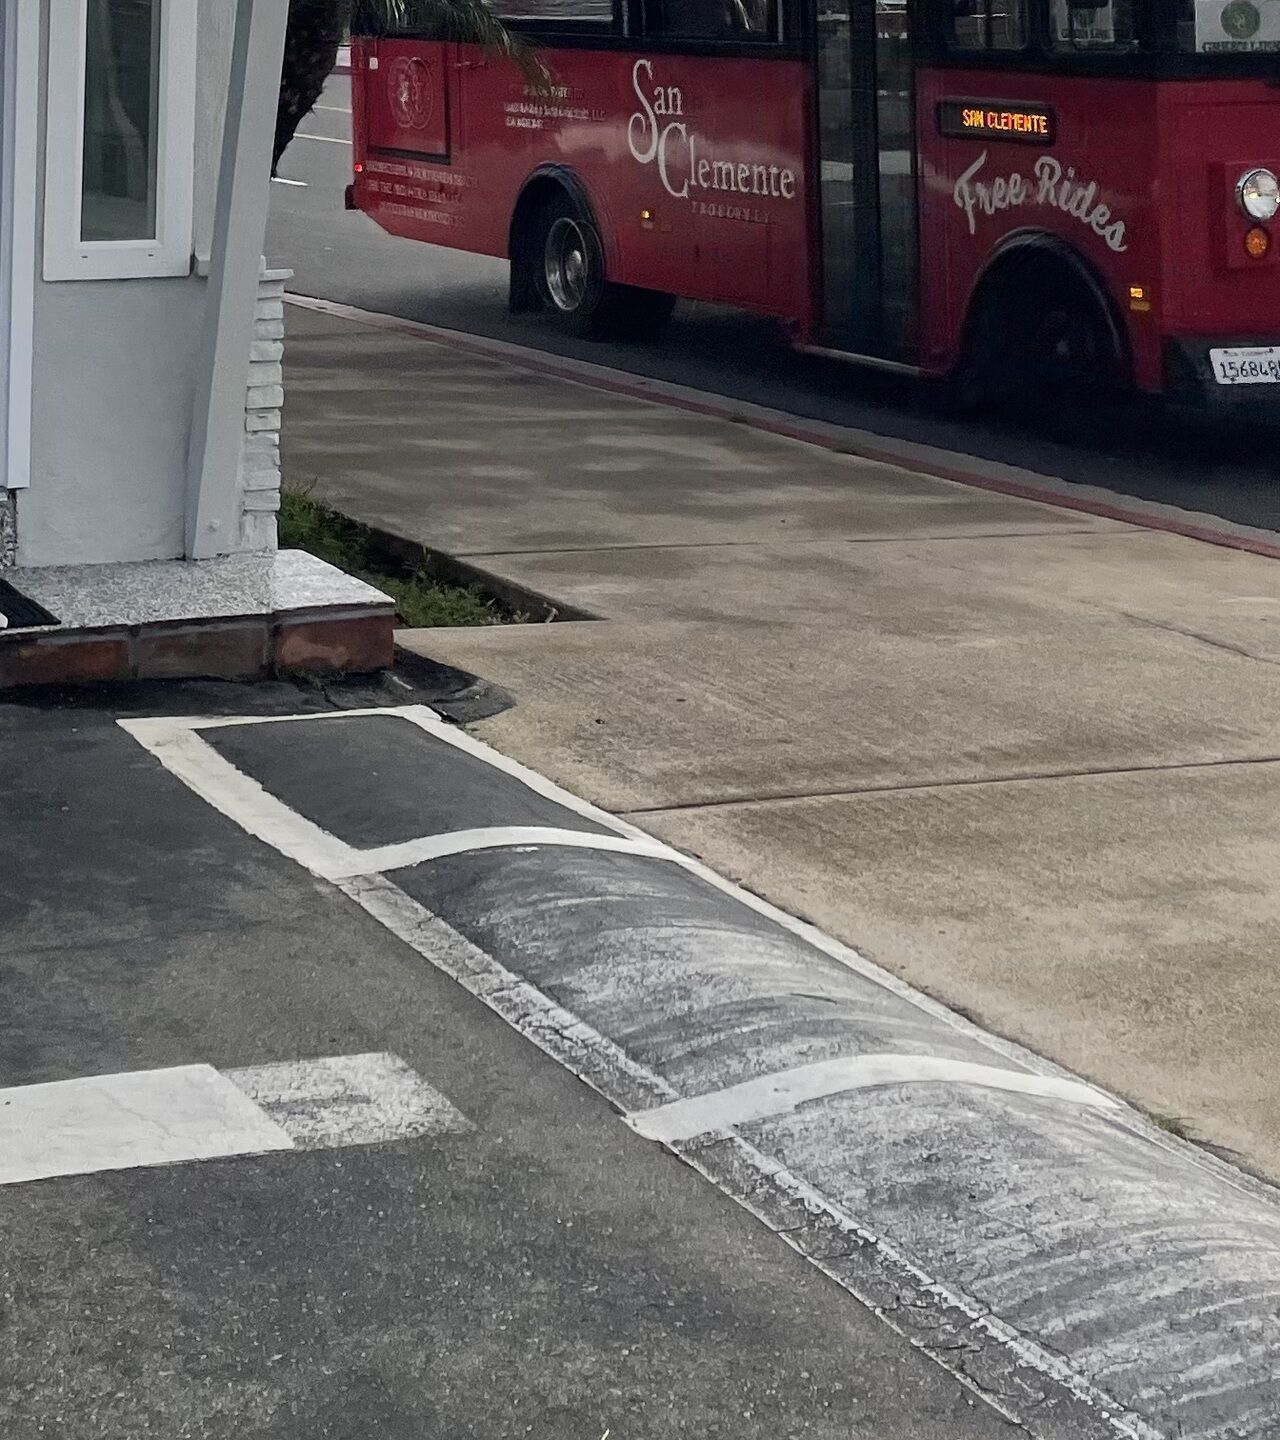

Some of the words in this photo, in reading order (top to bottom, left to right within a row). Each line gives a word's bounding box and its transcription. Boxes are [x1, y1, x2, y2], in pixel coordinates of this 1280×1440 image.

[627, 59, 684, 163] San
[962, 109, 984, 129] SAN
[987, 111, 1048, 134] CLEMENTE
[658, 122, 796, 199] Clemente
[953, 149, 1027, 235] Free
[1034, 155, 1128, 252] Rides
